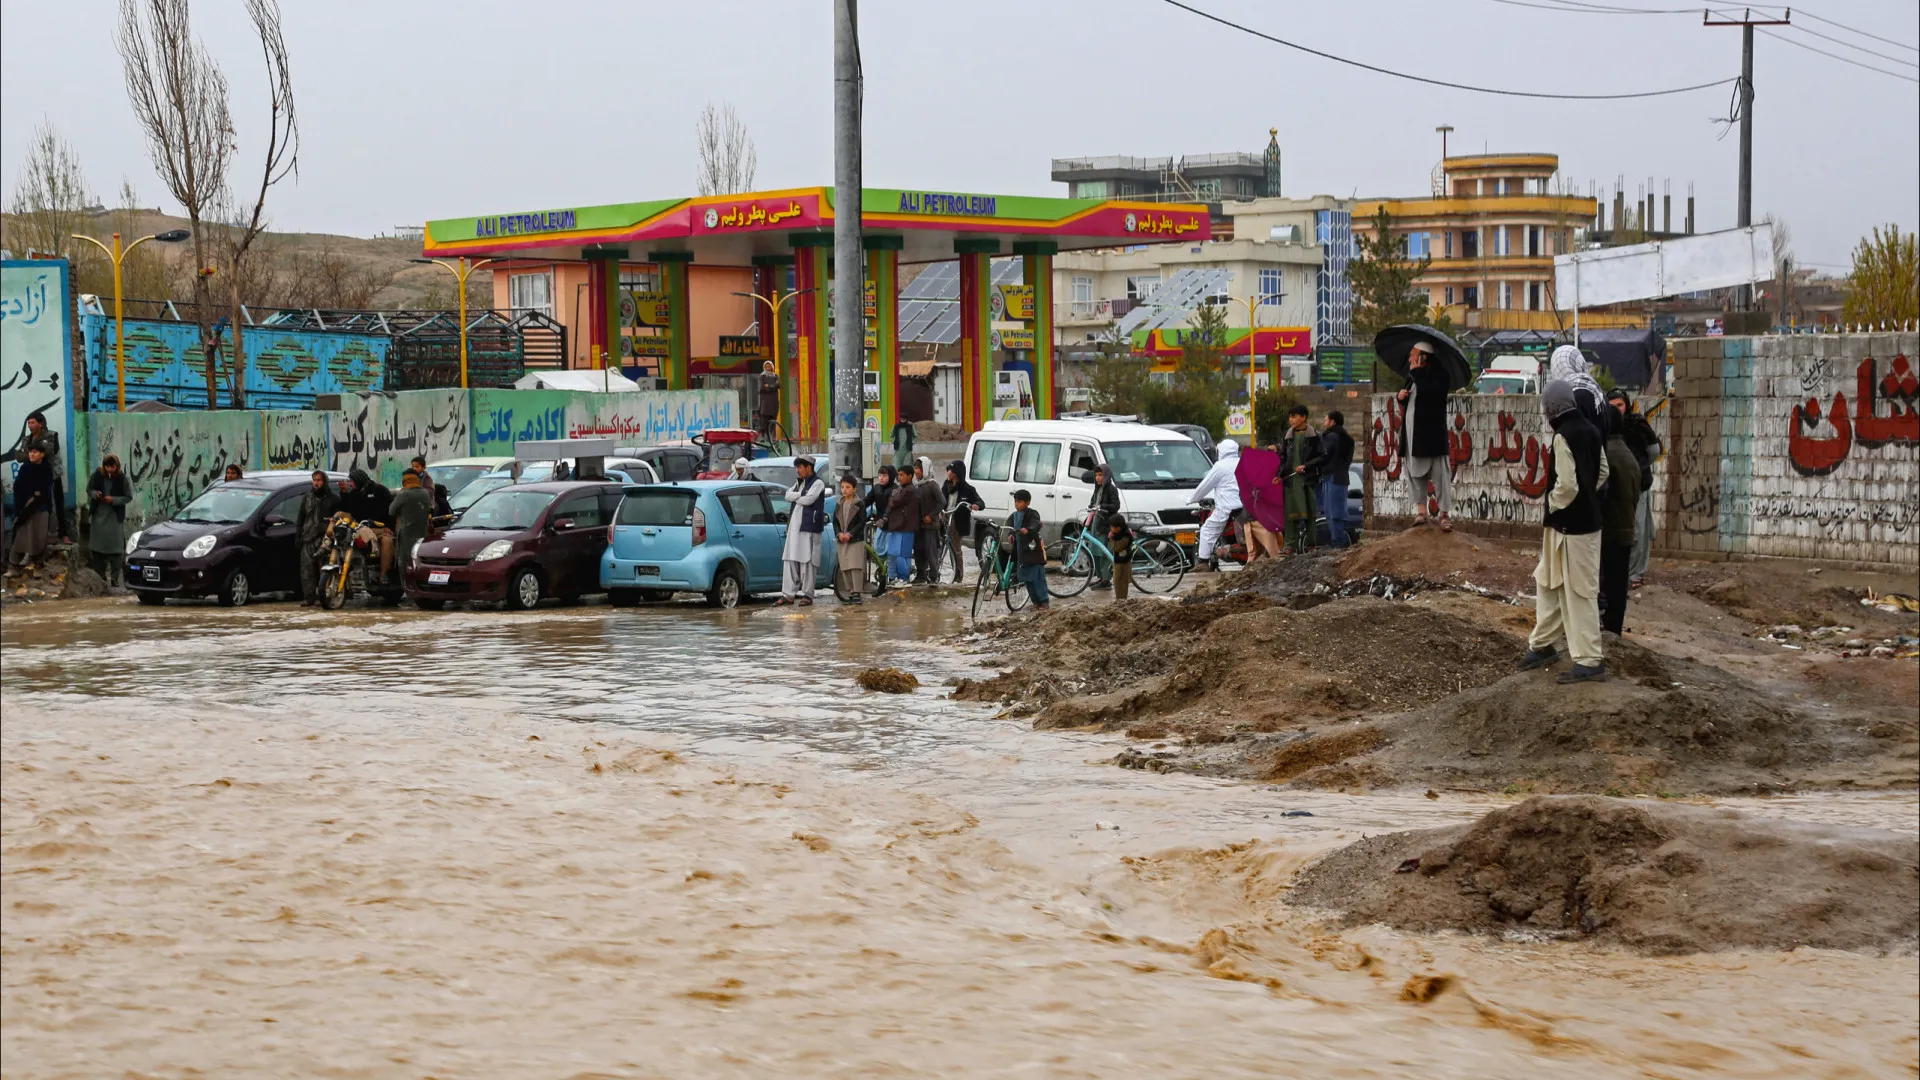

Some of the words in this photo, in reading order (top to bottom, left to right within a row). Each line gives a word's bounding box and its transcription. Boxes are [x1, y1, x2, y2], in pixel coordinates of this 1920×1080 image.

[767, 200, 801, 224] علی
[900, 193, 920, 212] ALI
[924, 194, 997, 216] PETROLEUM
[475, 215, 497, 237] ALI
[499, 209, 576, 234] PETROLEUM
[1174, 215, 1200, 234] علی
[1274, 335, 1298, 351] گاز
[475, 405, 514, 454] کاتب
[1229, 417, 1245, 426] LPG
